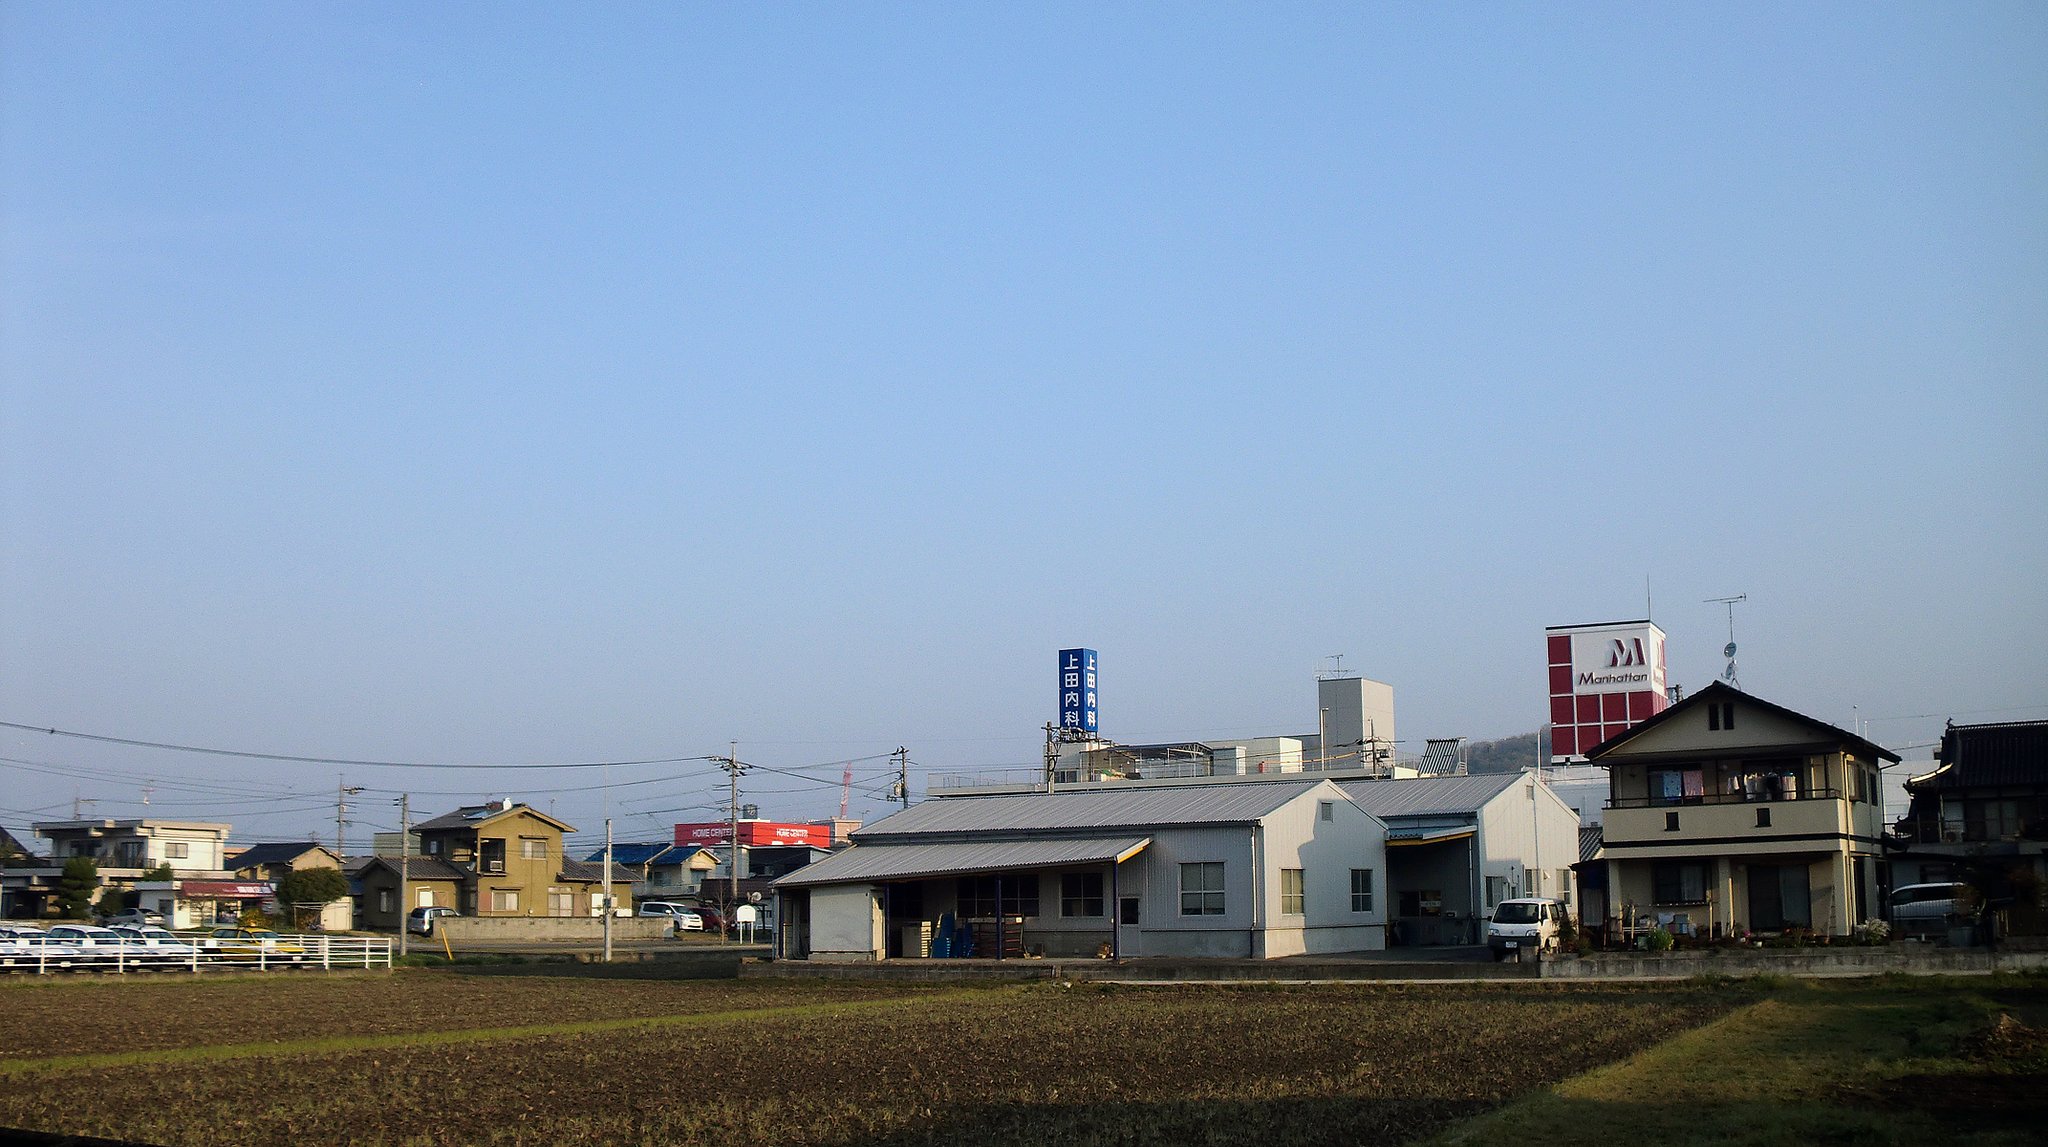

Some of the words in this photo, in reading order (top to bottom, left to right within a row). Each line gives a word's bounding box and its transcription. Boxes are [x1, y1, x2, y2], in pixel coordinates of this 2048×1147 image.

[1578, 672, 1648, 686] Manhattan
[1064, 654, 1079, 726] 上田内科
[1087, 654, 1096, 727] 上田内科
[693, 828, 710, 838] HOME
[711, 828, 732, 838] CENTE
[776, 829, 789, 837] HOME
